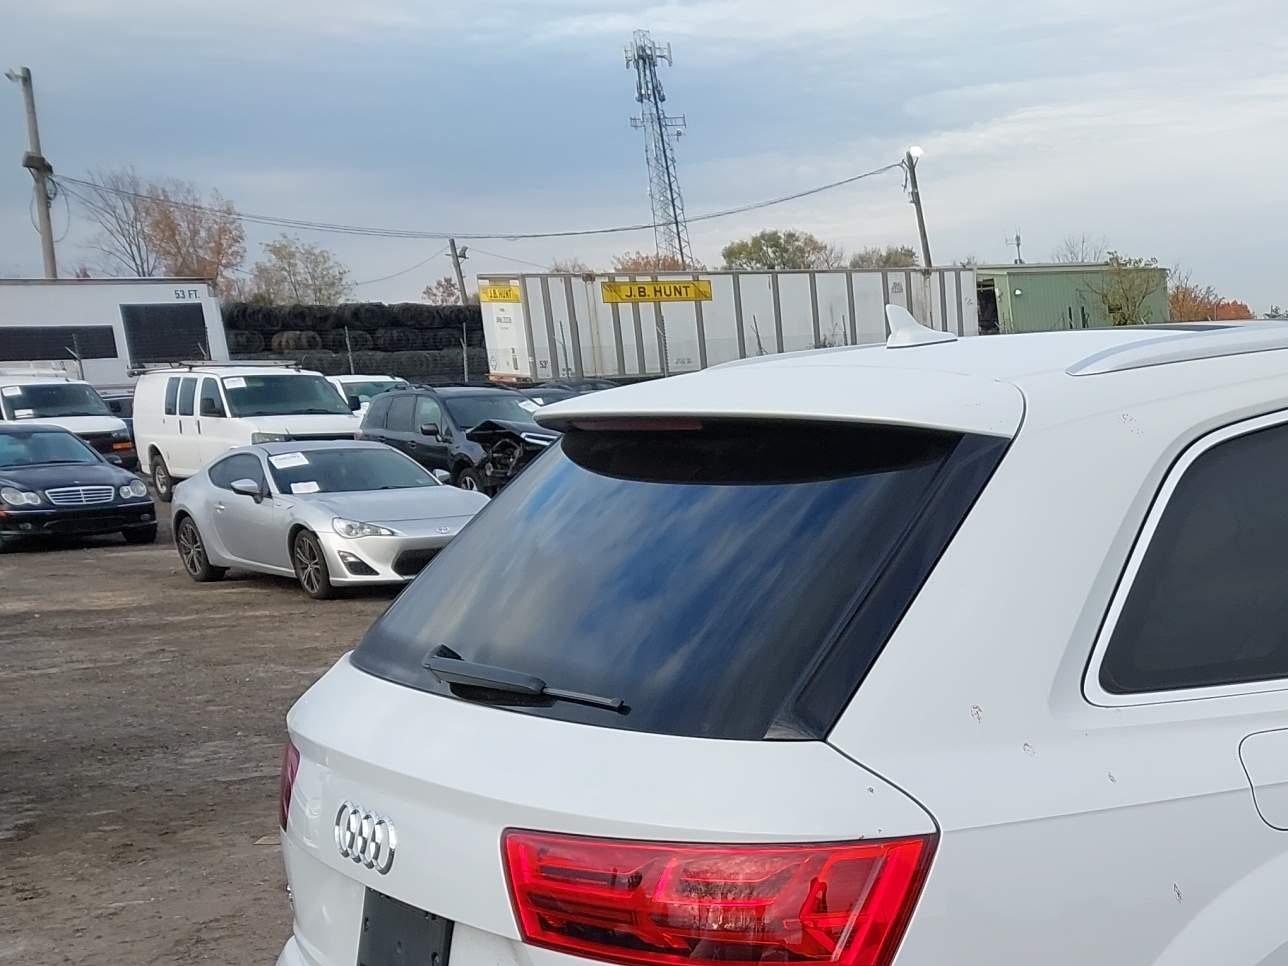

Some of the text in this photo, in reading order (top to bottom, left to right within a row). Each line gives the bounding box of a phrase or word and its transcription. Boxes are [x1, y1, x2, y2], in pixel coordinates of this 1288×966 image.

[174, 289, 186, 299] 53
[624, 286, 690, 298] J.B. HUNT
